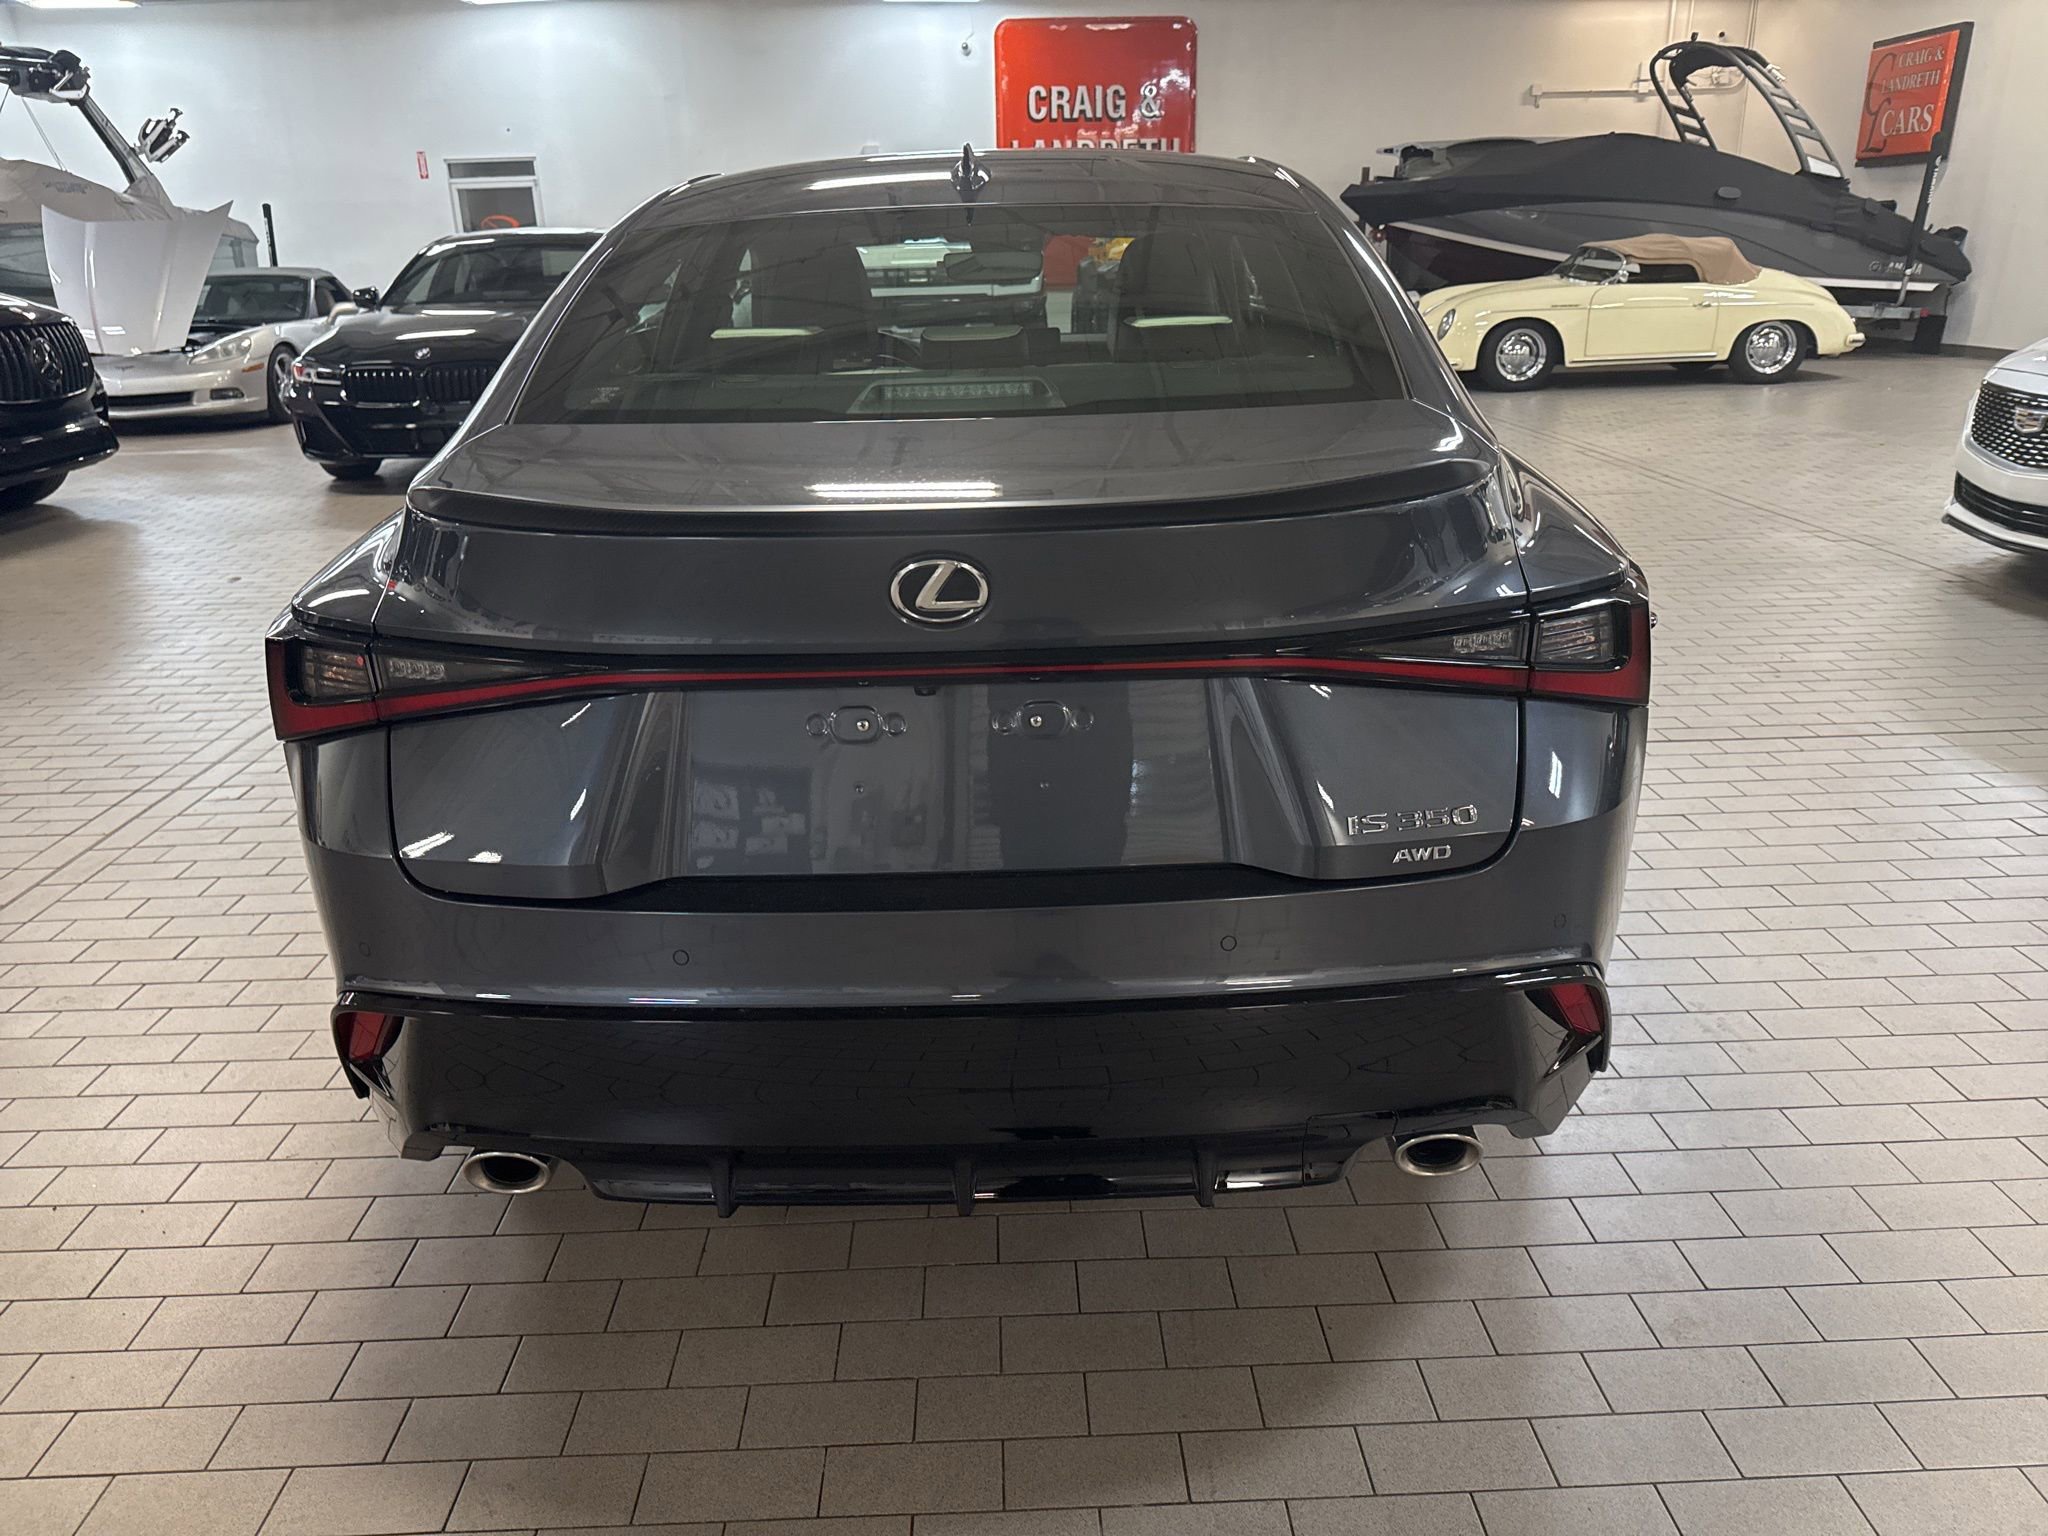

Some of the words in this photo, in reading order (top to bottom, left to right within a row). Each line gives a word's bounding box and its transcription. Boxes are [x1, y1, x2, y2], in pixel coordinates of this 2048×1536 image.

[1898, 47, 1933, 68] CRAIG
[1935, 45, 1945, 61] &
[1881, 69, 1941, 94] LANDRETH
[1027, 84, 1126, 121] CRAIG
[1140, 81, 1162, 118] &
[1880, 103, 1935, 137] CARS
[1347, 812, 1389, 836] IS
[1396, 804, 1478, 832] 350
[1392, 844, 1452, 864] AWD
